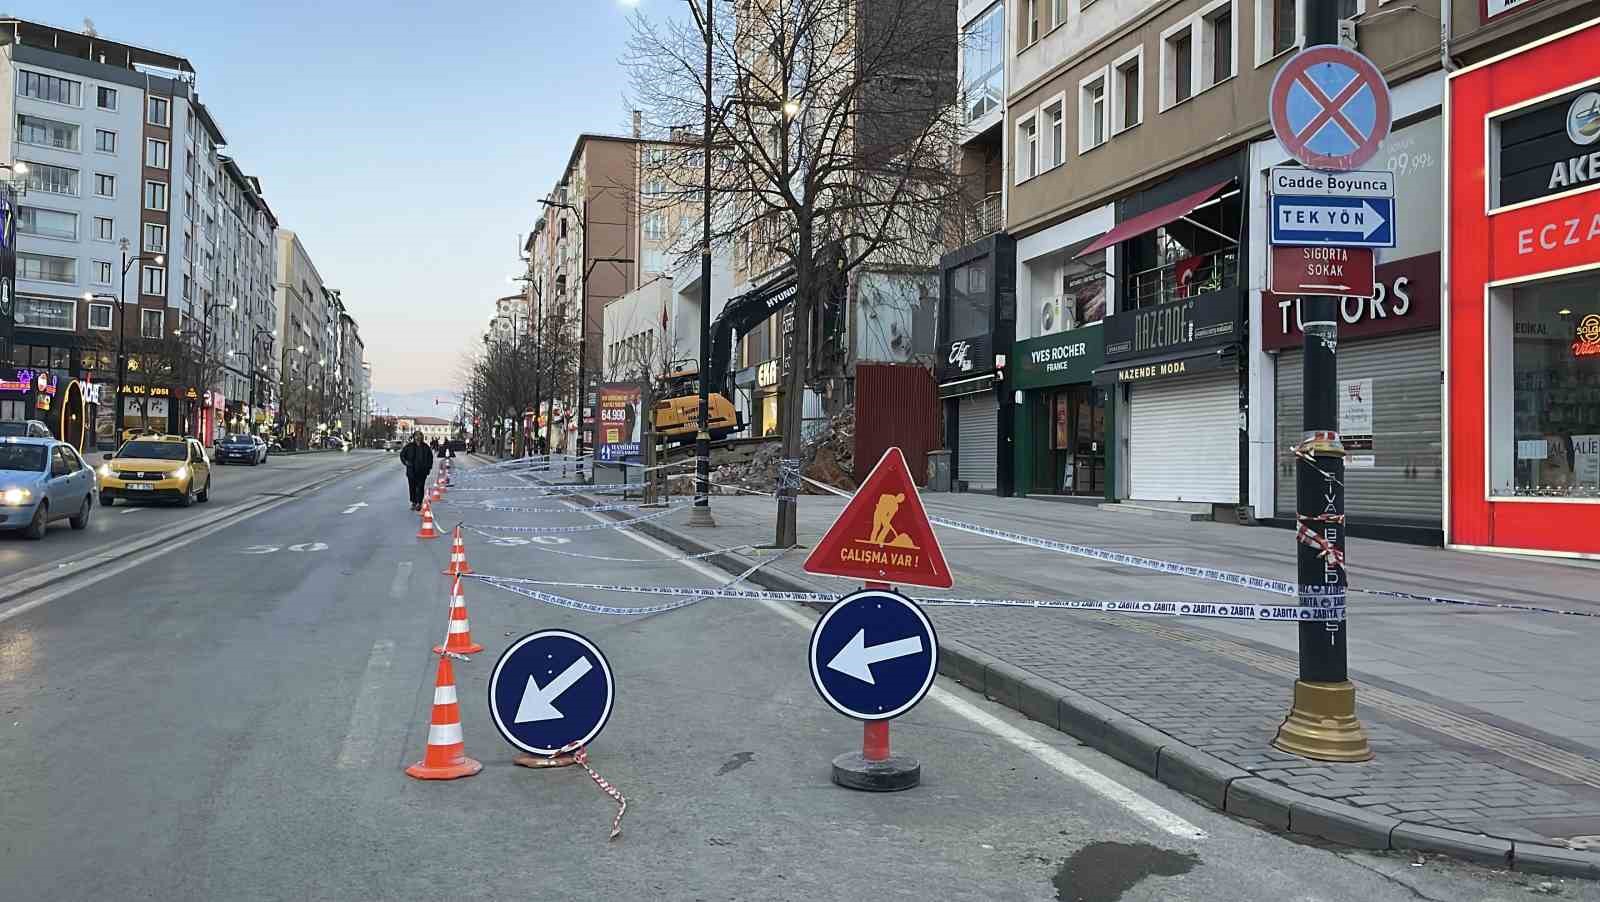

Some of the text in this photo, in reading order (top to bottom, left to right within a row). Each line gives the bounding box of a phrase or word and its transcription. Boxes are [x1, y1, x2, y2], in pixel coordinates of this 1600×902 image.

[1279, 175, 1387, 193] Cadde Boyunca
[1283, 209, 1364, 225] TEK YÖN
[1307, 263, 1343, 277] SOKAK
[1032, 343, 1086, 364] YVES ROCHER
[1047, 361, 1068, 373] FRANCE
[1118, 362, 1185, 381] NAZENDE MODA
[840, 547, 888, 565] ÇALIŞMA
[891, 553, 912, 567] VAR
[1153, 603, 1176, 611] ZABITA
[1192, 604, 1216, 614] ZABITA
[1231, 606, 1255, 616] ZABITA
[1273, 608, 1298, 618] ZABITA
[1312, 608, 1338, 619] ZABITA
